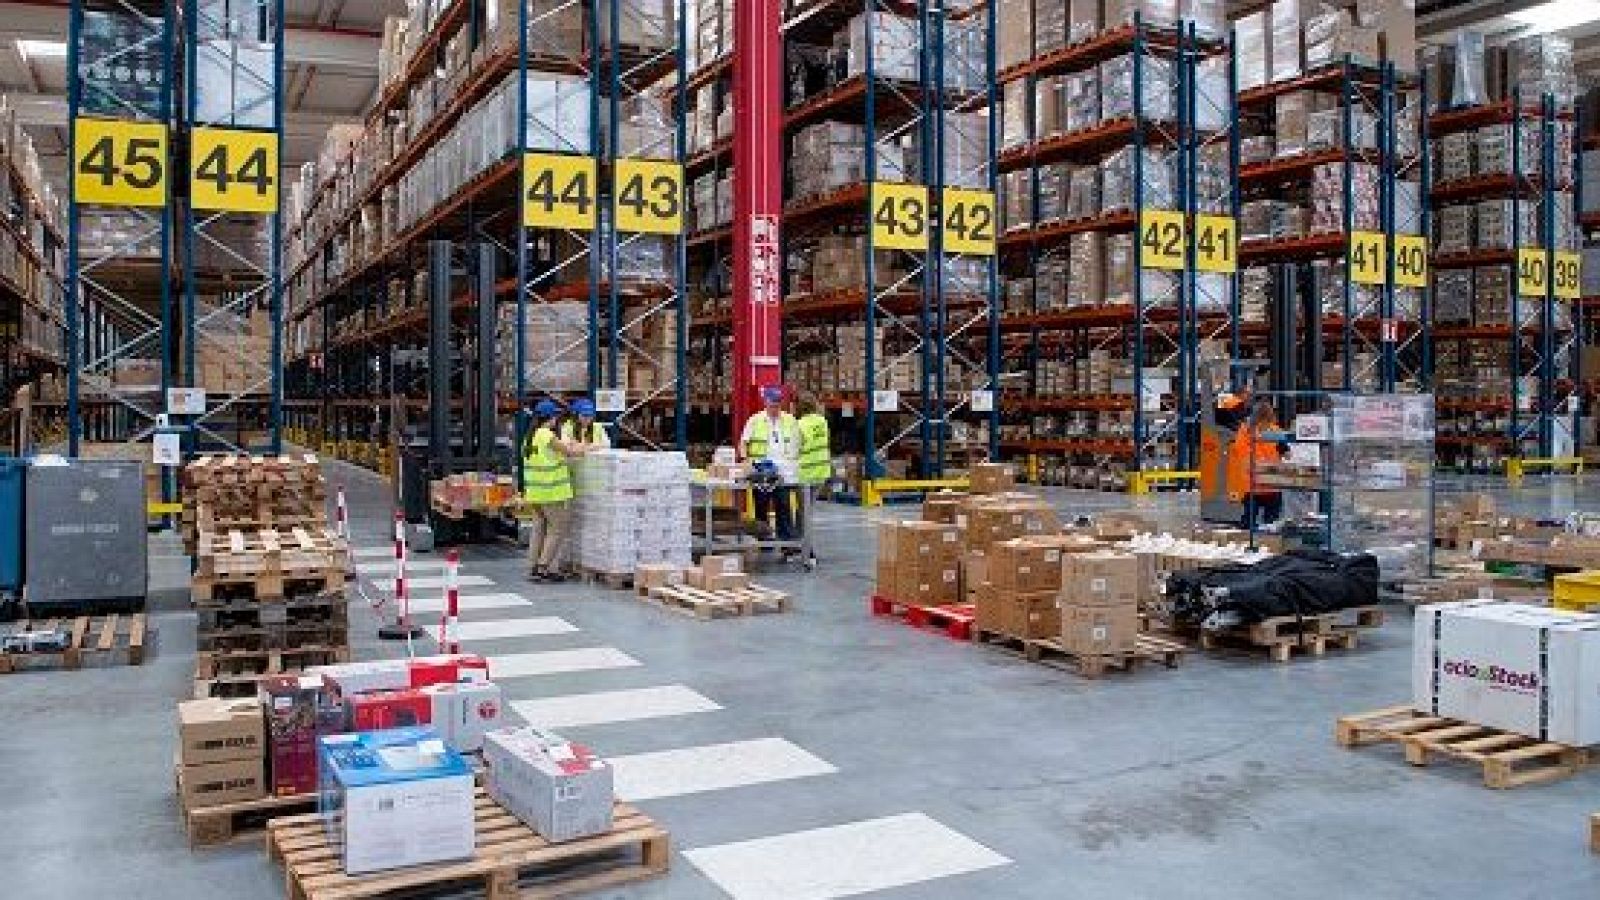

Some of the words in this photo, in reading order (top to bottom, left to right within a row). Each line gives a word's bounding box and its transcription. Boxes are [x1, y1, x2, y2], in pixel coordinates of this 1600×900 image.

[80, 135, 163, 189] 45
[195, 144, 273, 195] 44
[526, 170, 594, 215] 44
[618, 173, 678, 218] 43
[873, 196, 925, 236] 43
[944, 202, 994, 241] 42
[1142, 222, 1183, 258] 42
[1196, 226, 1231, 261] 41
[1352, 242, 1379, 273] 41
[1396, 245, 1425, 276] 40
[1520, 256, 1544, 288] 40
[1555, 259, 1579, 290] 39
